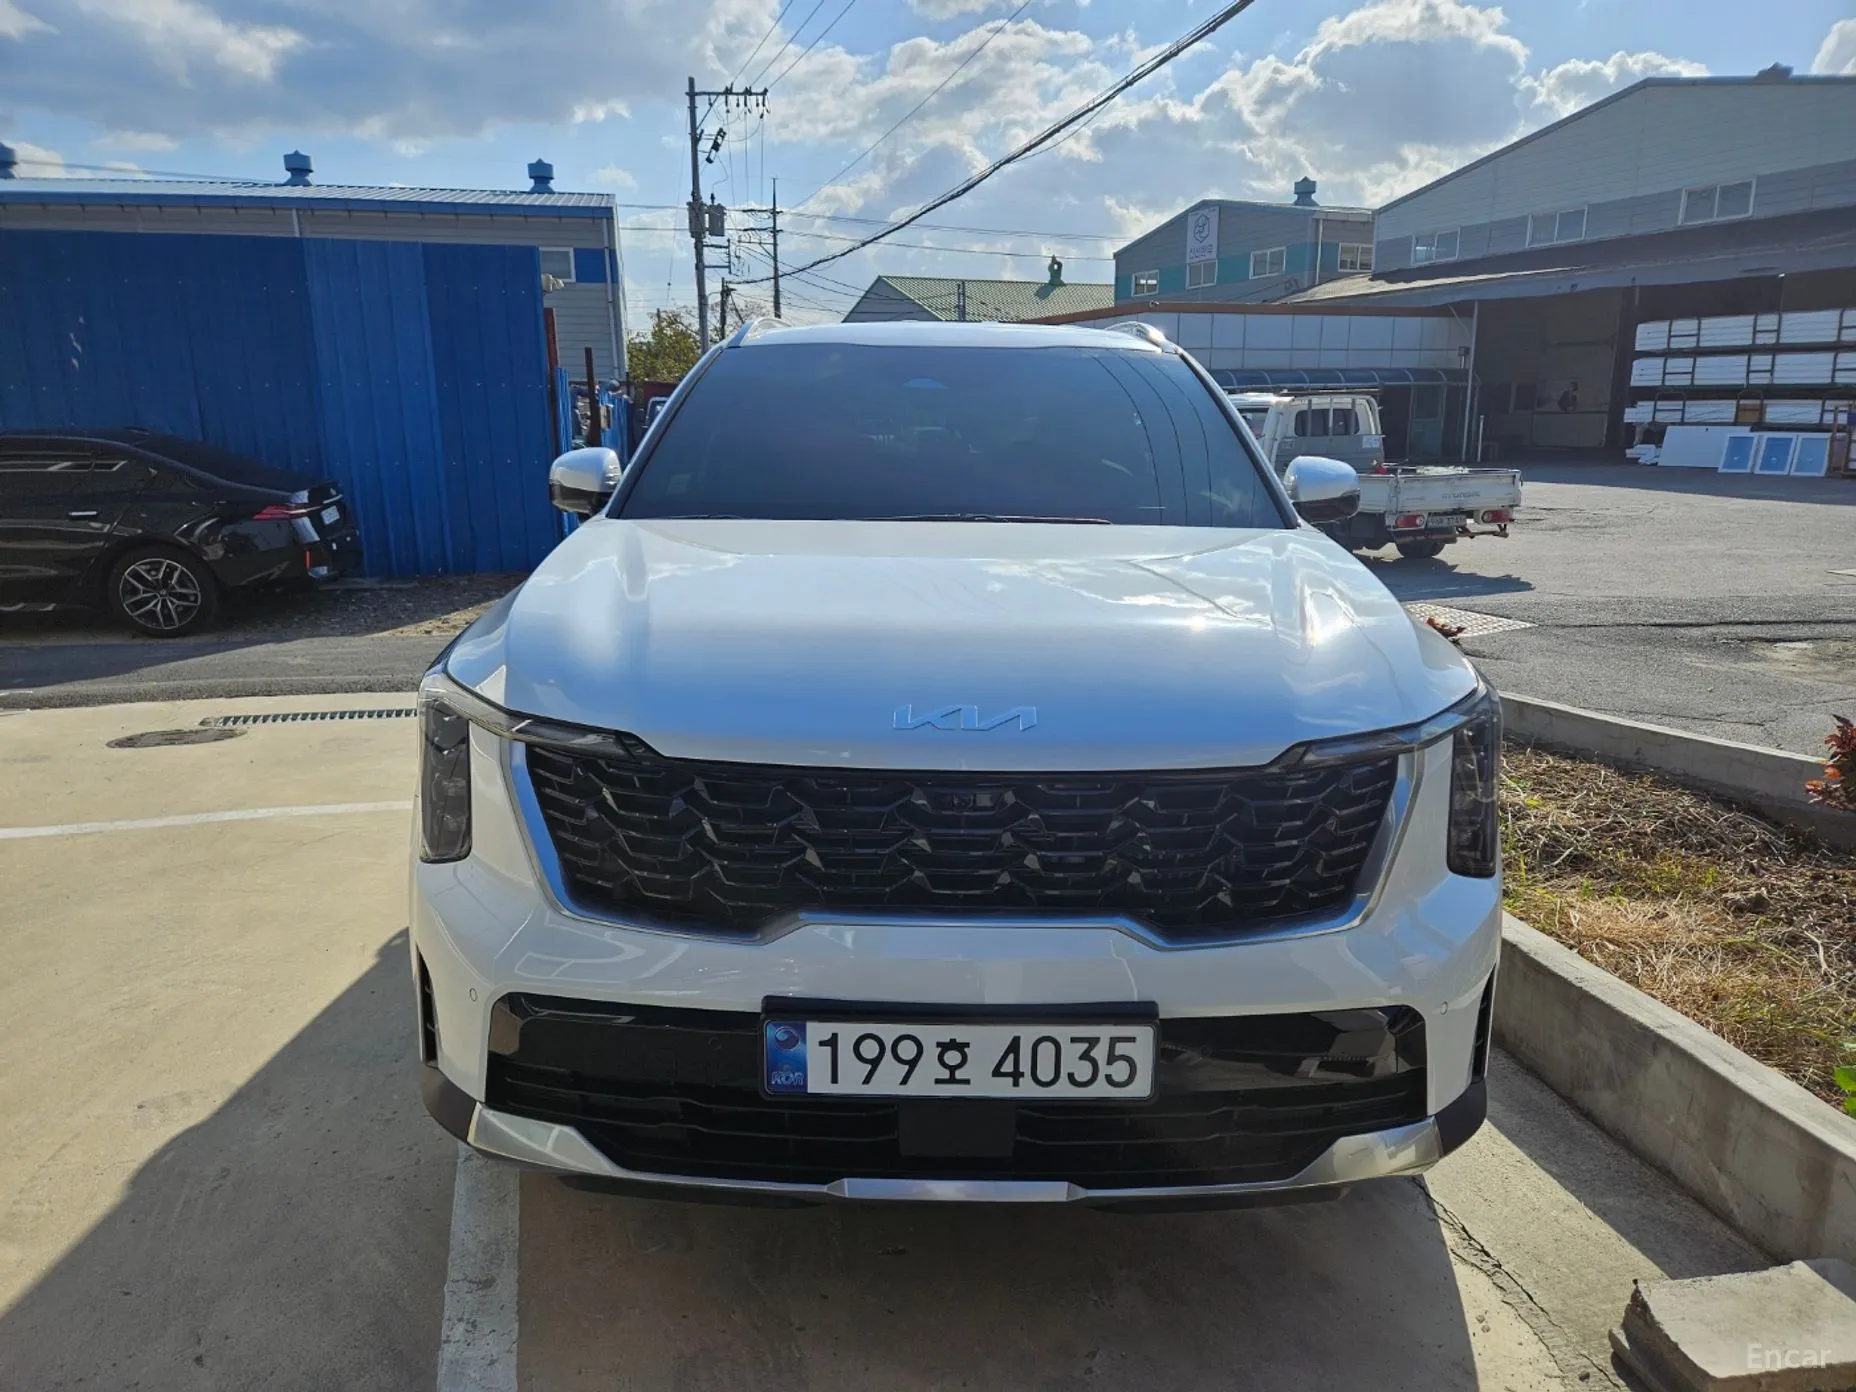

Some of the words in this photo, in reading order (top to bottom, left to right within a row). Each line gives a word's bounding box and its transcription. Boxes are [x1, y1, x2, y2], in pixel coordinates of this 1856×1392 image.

[893, 704, 1037, 732] KIA
[818, 1032, 971, 1086] 199호
[991, 1035, 1138, 1089] 4035
